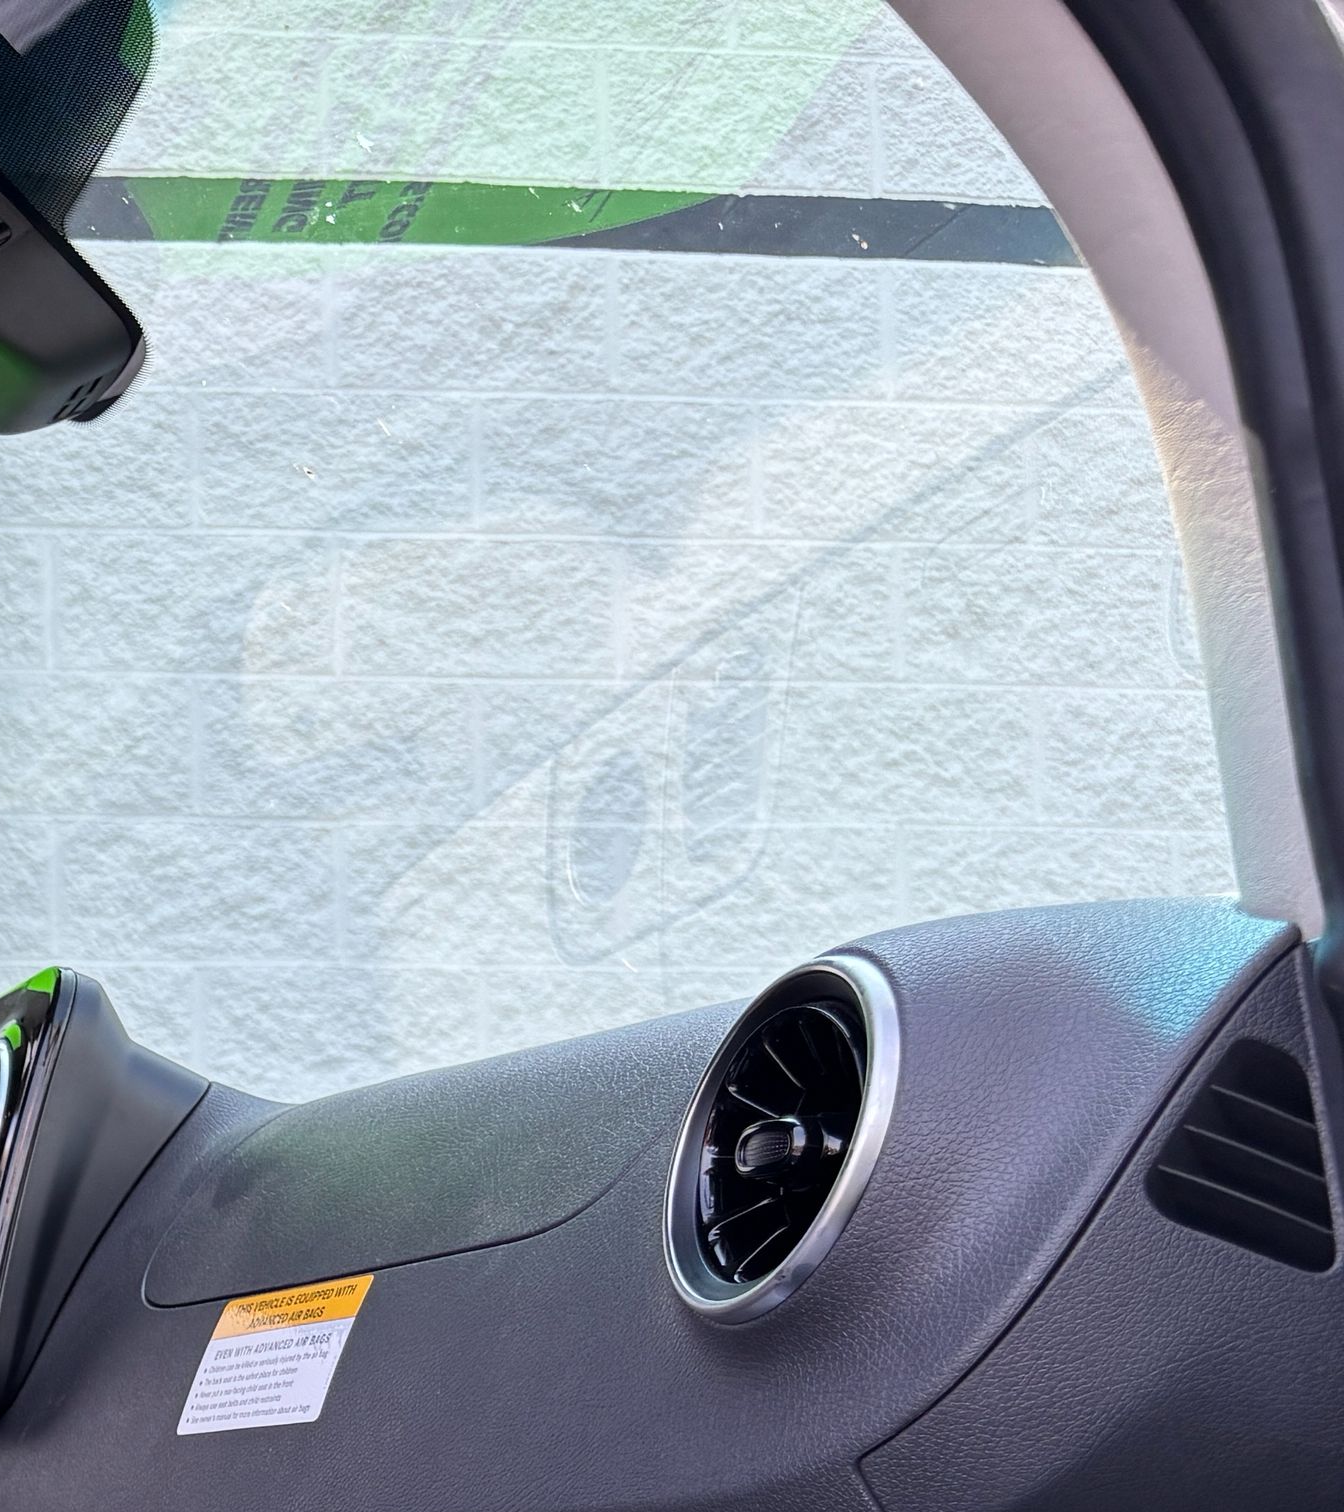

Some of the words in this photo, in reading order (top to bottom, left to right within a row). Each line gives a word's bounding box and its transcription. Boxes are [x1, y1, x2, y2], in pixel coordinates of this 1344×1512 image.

[254, 1297, 284, 1311] VEHICLE
[294, 1288, 333, 1304] EQUIPPED
[334, 1284, 356, 1296] WITH
[248, 1312, 288, 1328] ADVANCED
[288, 1309, 303, 1321] AIR
[303, 1306, 325, 1319] BAGS
[215, 1348, 233, 1360] EVEN
[234, 1345, 252, 1356] WITH
[254, 1339, 293, 1353] ADVANCED
[295, 1336, 309, 1347] AIR
[309, 1333, 331, 1345] BAGS
